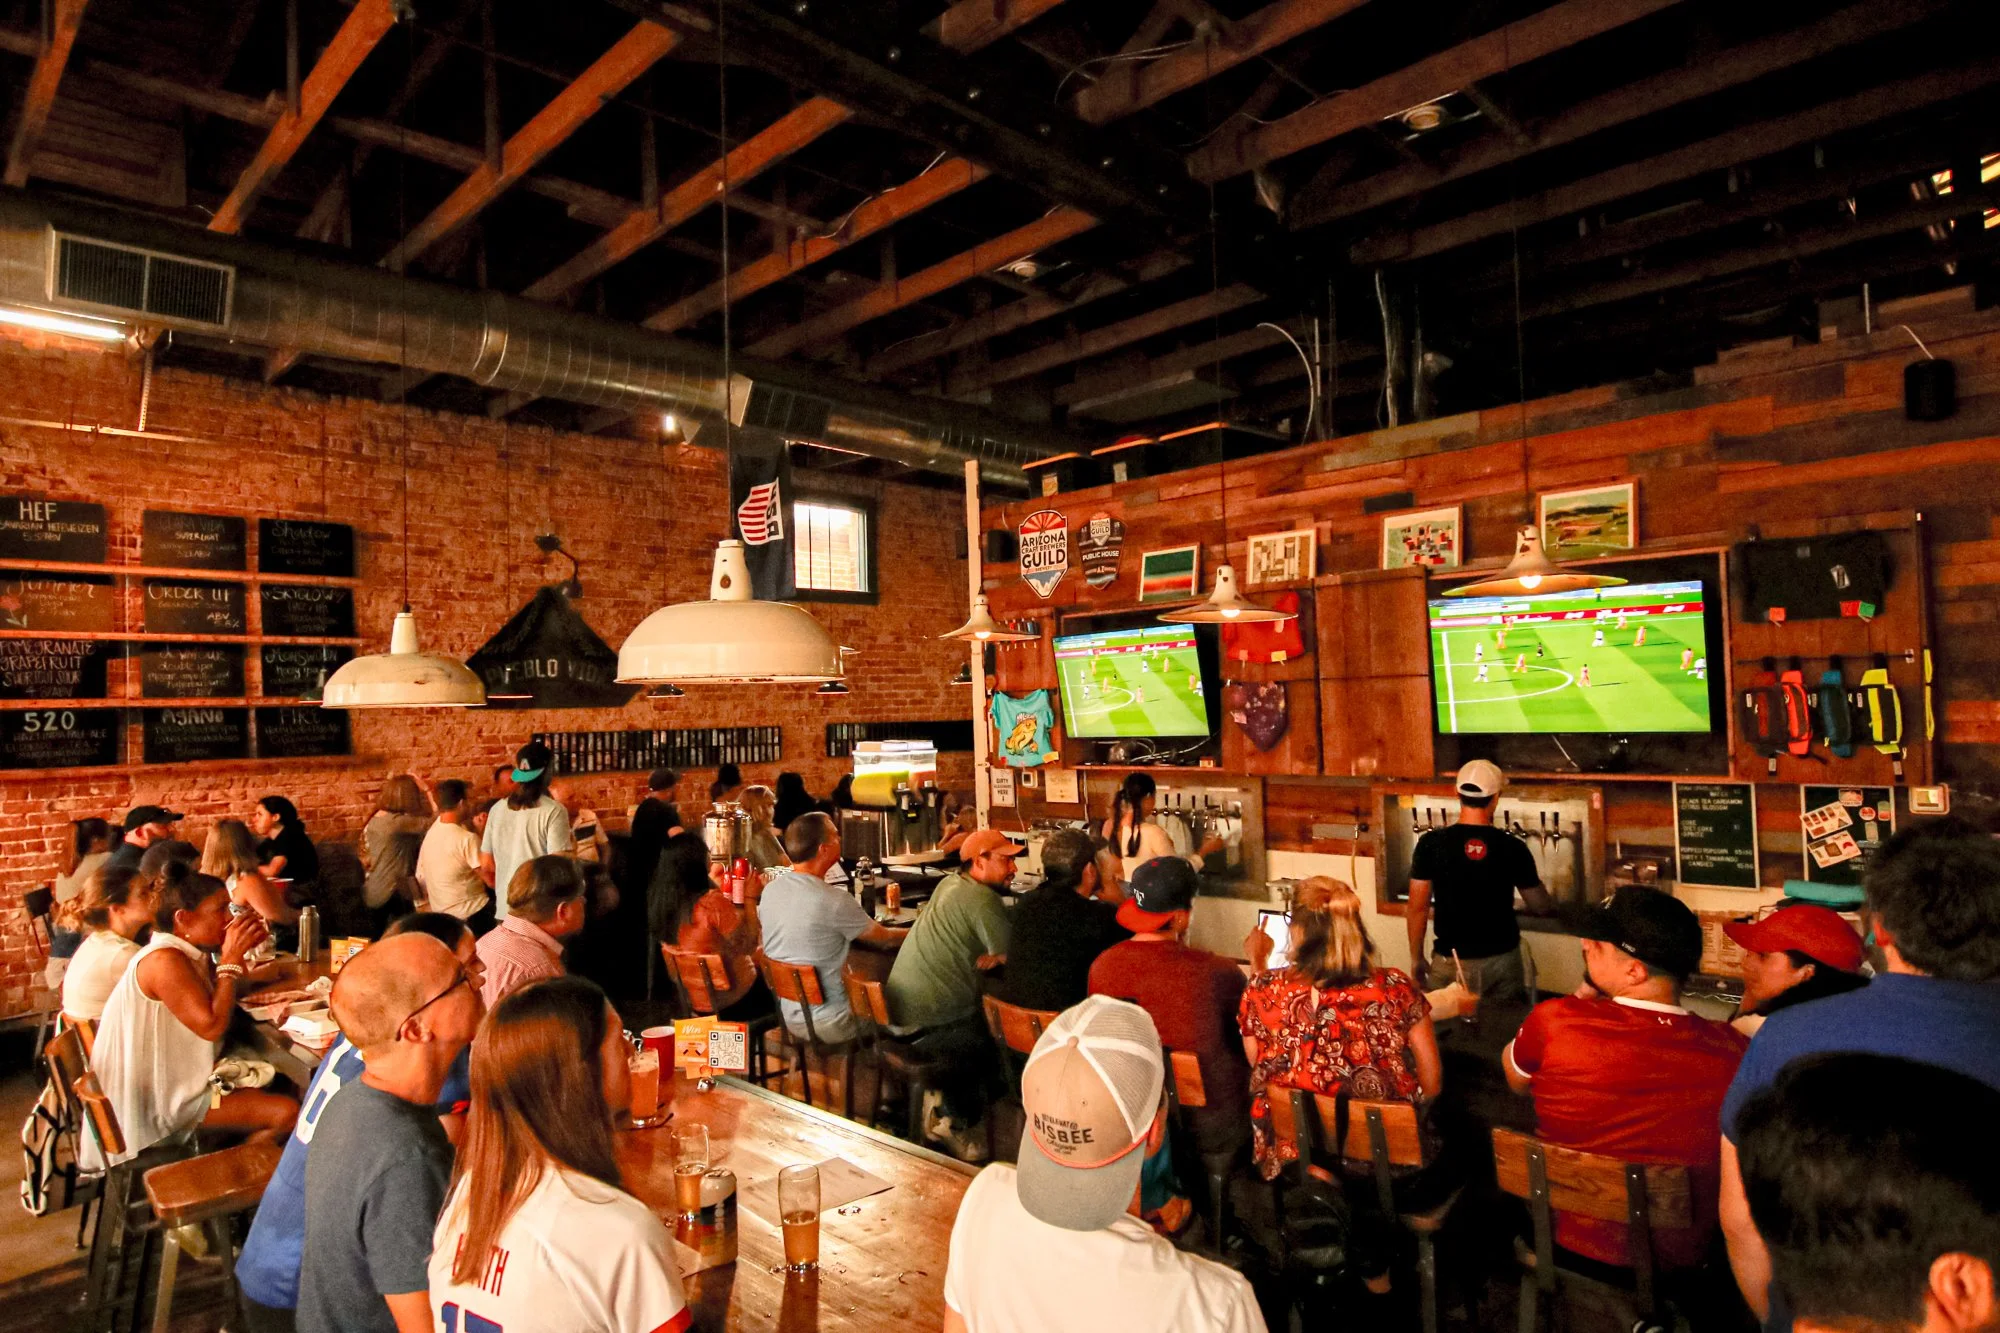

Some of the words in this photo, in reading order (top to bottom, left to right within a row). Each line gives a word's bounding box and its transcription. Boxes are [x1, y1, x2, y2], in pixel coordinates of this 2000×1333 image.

[19, 500, 57, 521] HEF
[1021, 530, 1066, 548] ARIZONA
[1091, 527, 1110, 535] GUILD
[1021, 546, 1039, 555] CRAFT
[1039, 541, 1066, 552] BREWERS
[1082, 552, 1101, 561] PUBLIC
[1101, 550, 1120, 558] HOUSE
[1021, 548, 1066, 569] GUILD
[148, 584, 205, 601] ORDER
[0, 654, 83, 672] GRAPEFRUIT
[23, 710, 76, 734] 520
[681, 1023, 702, 1035] Win
[1033, 1112, 1095, 1145] BISBEE
